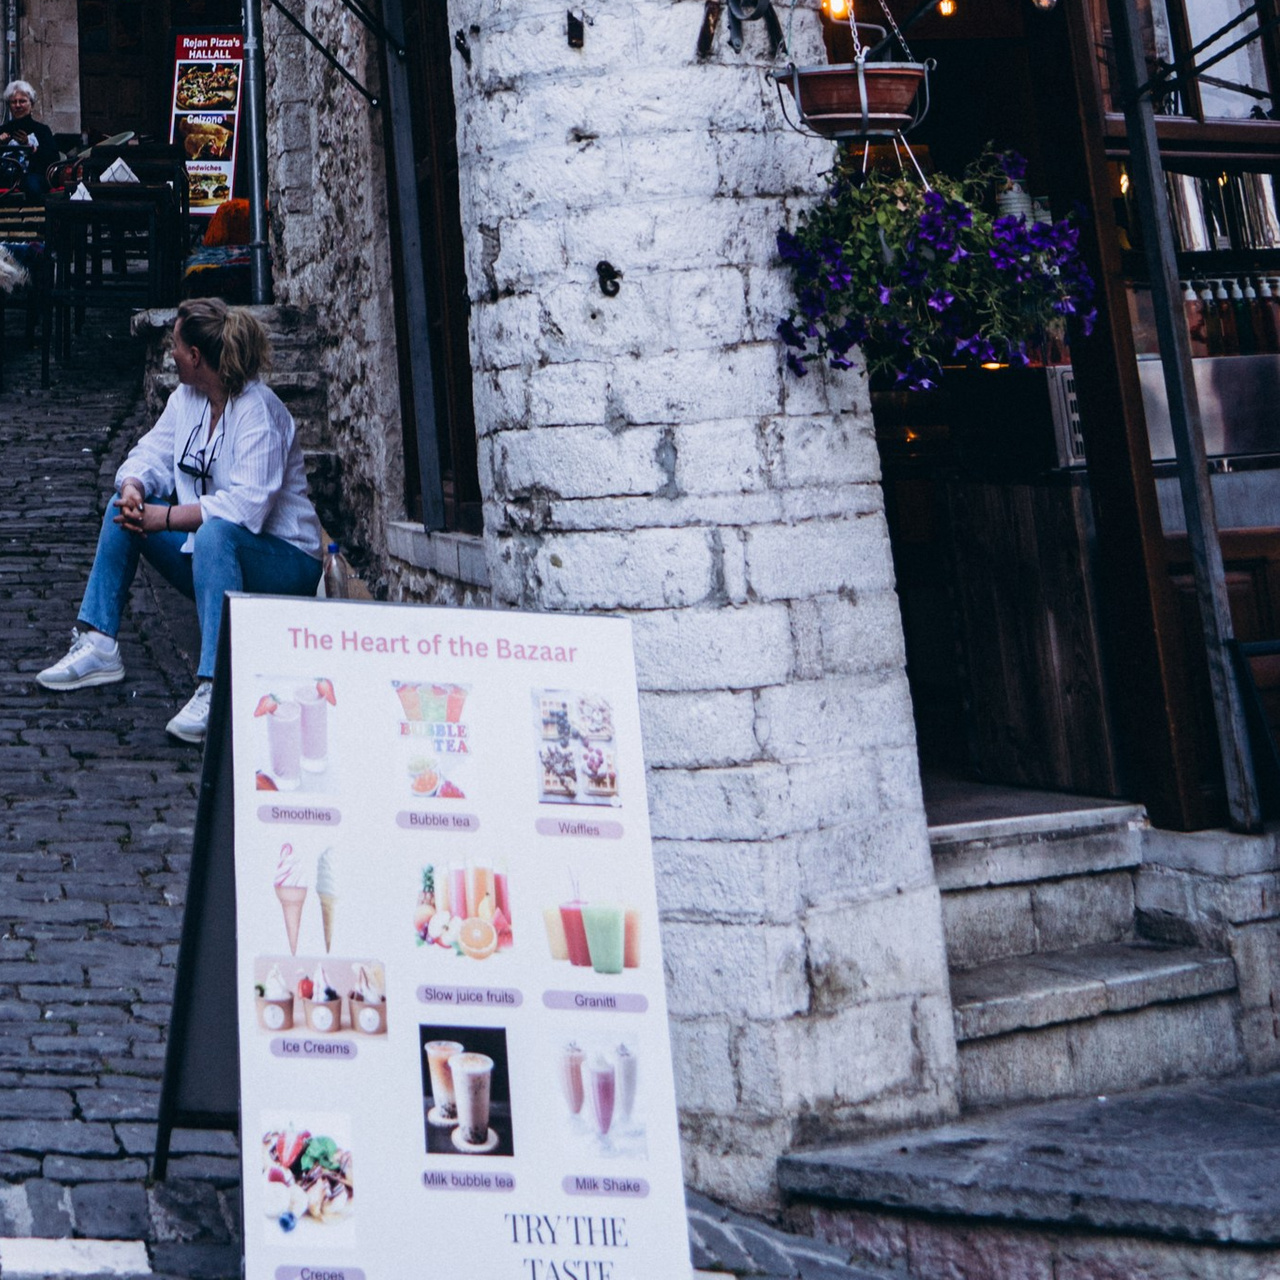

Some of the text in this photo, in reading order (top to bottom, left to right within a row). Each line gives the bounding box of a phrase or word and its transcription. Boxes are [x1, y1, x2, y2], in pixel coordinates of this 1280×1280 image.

[210, 37, 241, 48] Pizza's
[188, 50, 232, 59] HALLALL
[186, 164, 222, 172] andwiches
[288, 627, 578, 663] The Heart of the Bazaar
[434, 739, 468, 753] TEA
[271, 806, 332, 822] Smoothies
[409, 812, 470, 828] Bubble tea
[558, 822, 600, 836] Waffles
[424, 988, 515, 1005] Slow juice fruits
[574, 994, 617, 1008] Granitti
[282, 1040, 350, 1055] Ice Creams
[423, 1173, 514, 1189] Milk bubble tea
[575, 1178, 640, 1193] Milk Shake
[504, 1213, 629, 1247] TRY THE
